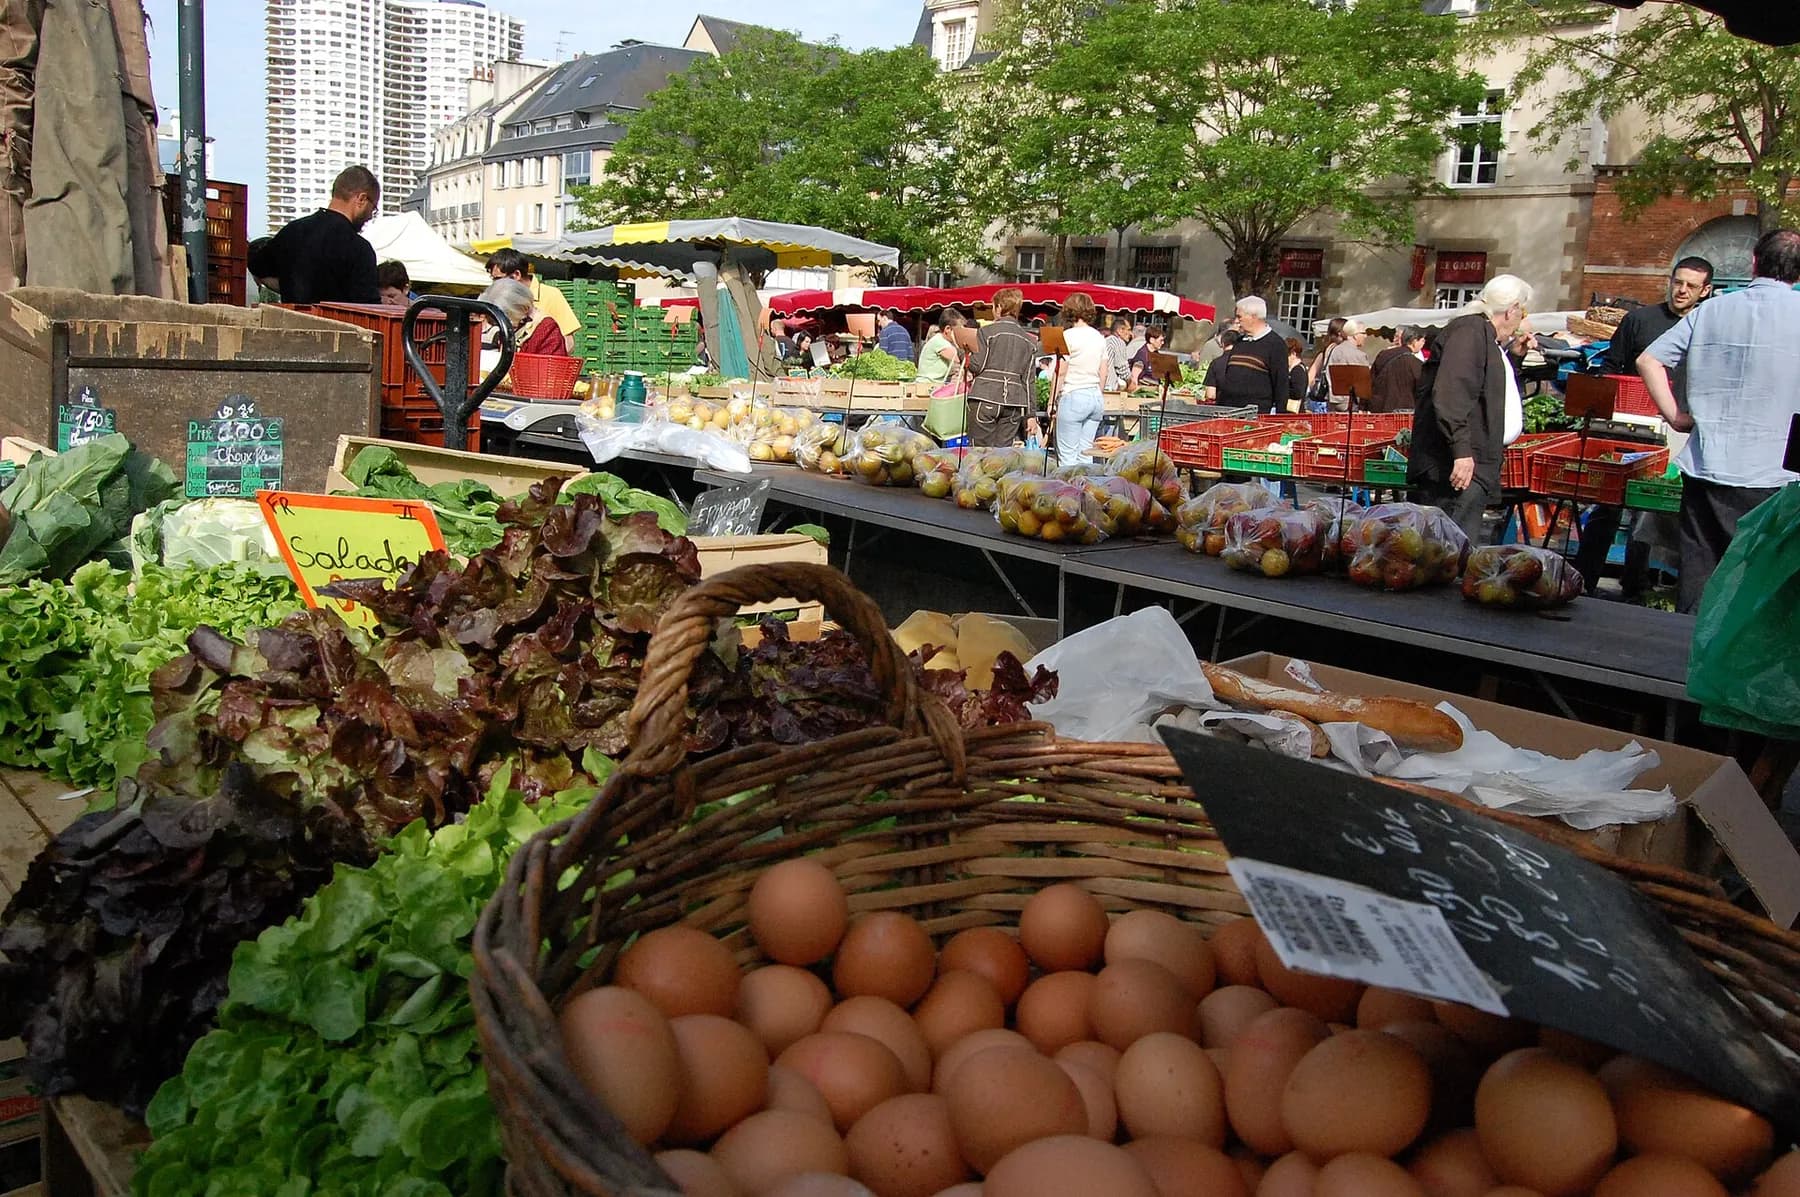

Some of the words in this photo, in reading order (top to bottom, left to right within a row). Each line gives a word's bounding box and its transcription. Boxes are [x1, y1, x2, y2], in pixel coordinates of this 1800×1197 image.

[188, 421, 213, 441] Prix
[266, 422, 281, 440] €
[266, 493, 295, 516] FR
[393, 503, 419, 520] II
